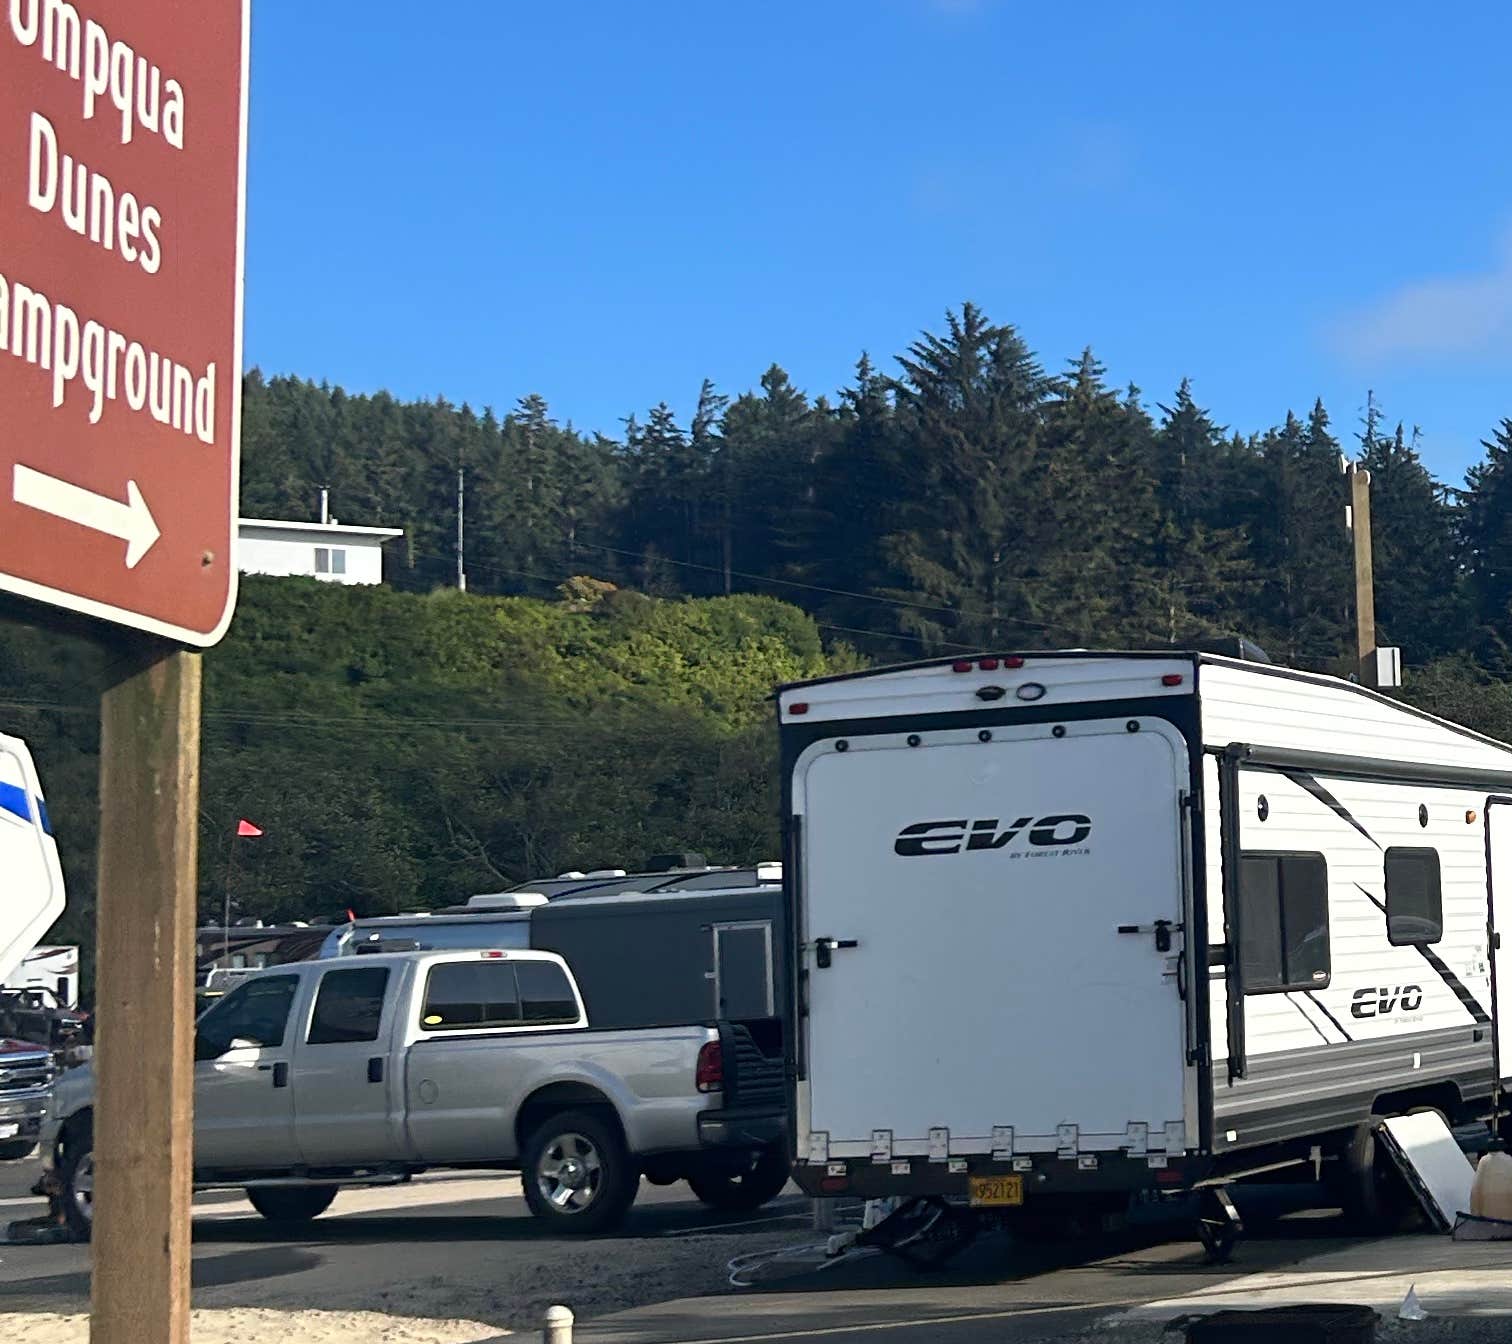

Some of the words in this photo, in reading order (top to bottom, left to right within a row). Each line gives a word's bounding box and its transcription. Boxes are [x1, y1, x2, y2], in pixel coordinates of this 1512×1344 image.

[29, 111, 161, 274] Dunes
[894, 814, 1092, 857] EVO
[1351, 985, 1423, 1019] EVO
